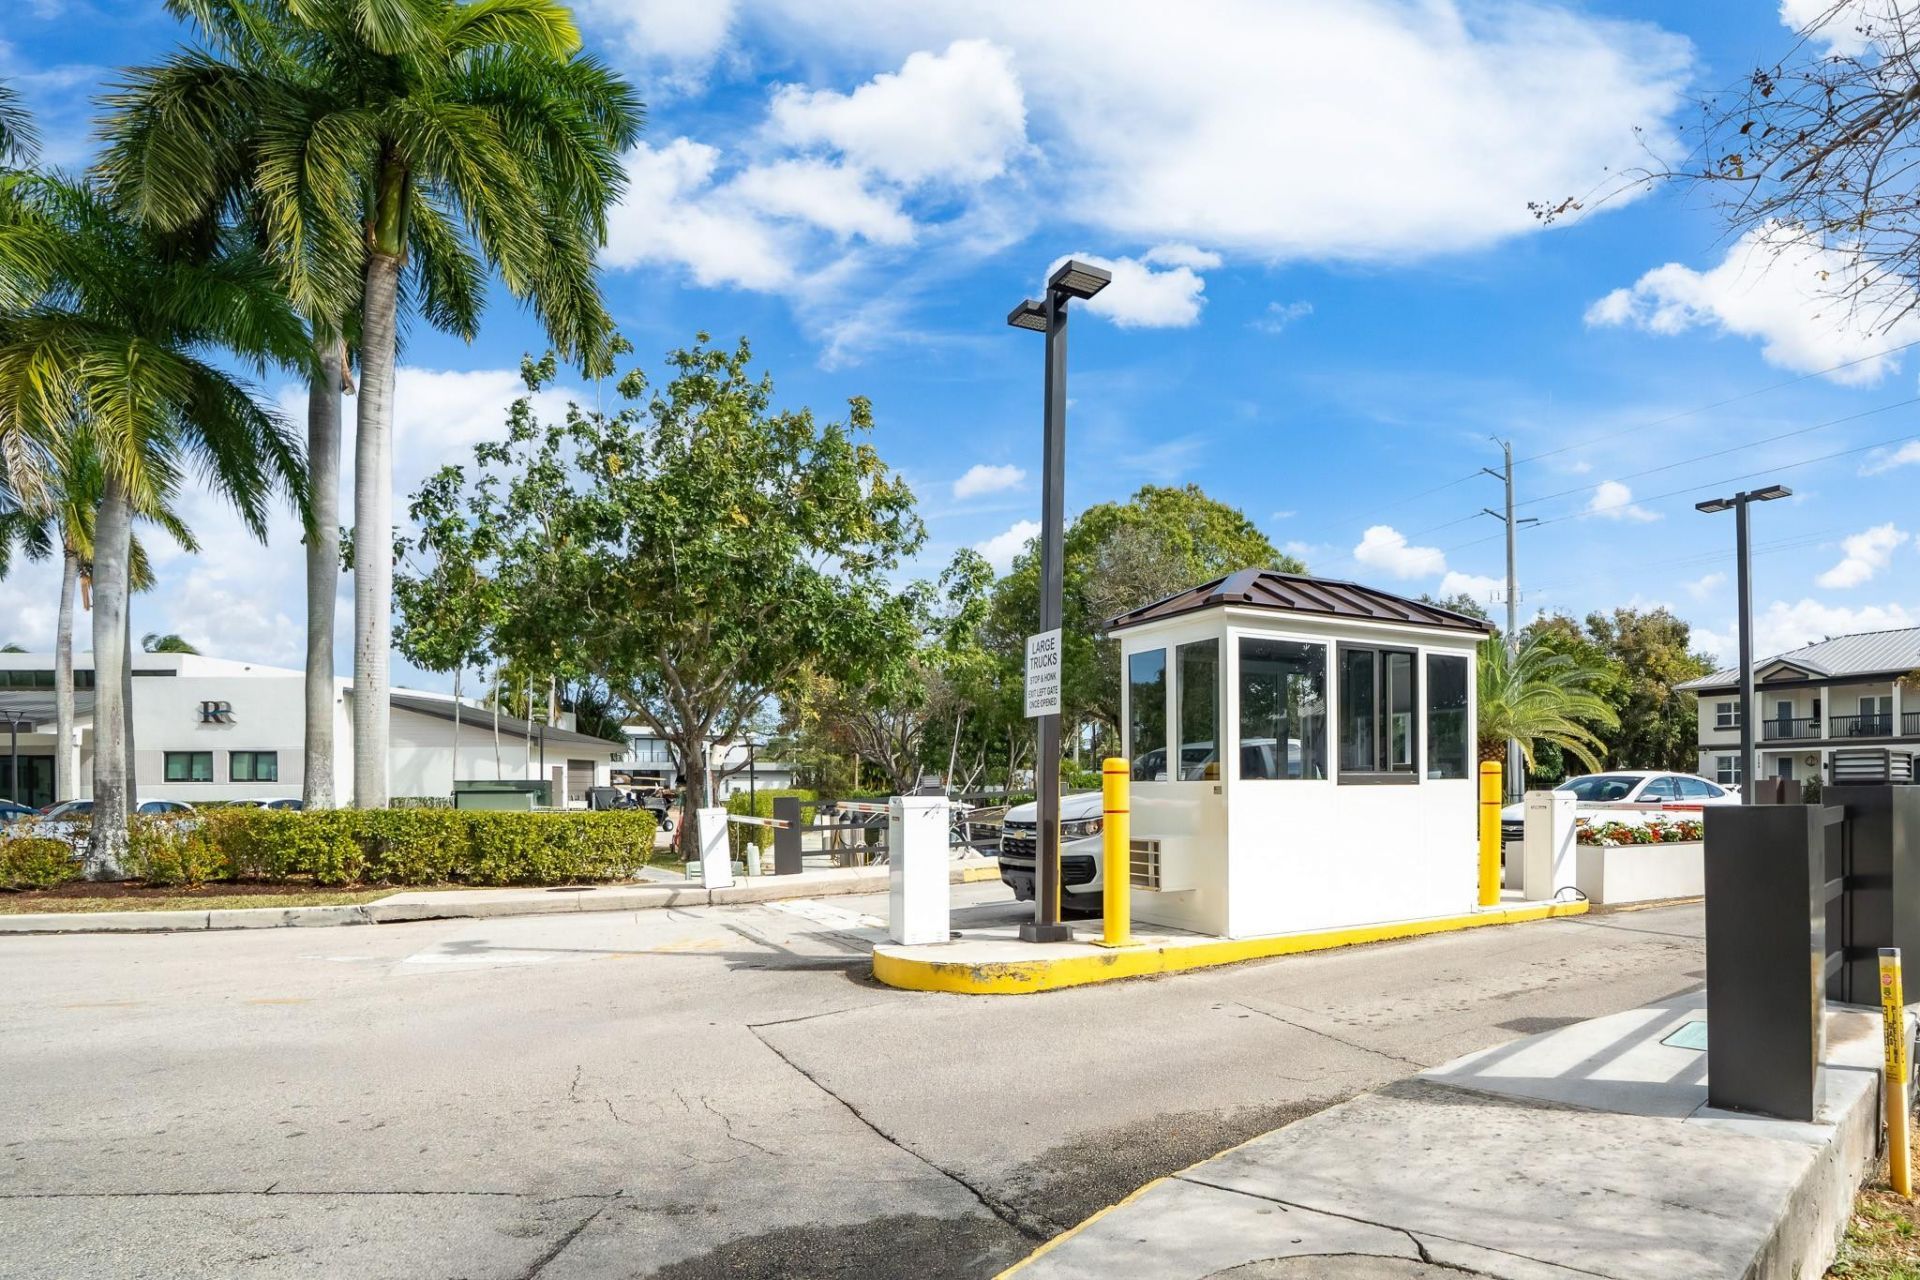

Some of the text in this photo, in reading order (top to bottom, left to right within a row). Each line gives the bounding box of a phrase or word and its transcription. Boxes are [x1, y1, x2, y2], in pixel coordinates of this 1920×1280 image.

[1032, 637, 1055, 654] LARGE
[1030, 652, 1057, 670] TRUCKS
[1030, 675, 1040, 685] STOP
[1044, 672, 1056, 681] HONK
[1028, 685, 1058, 698] EXIT LEFT GATE
[1029, 697, 1057, 709] ONCE OPENED
